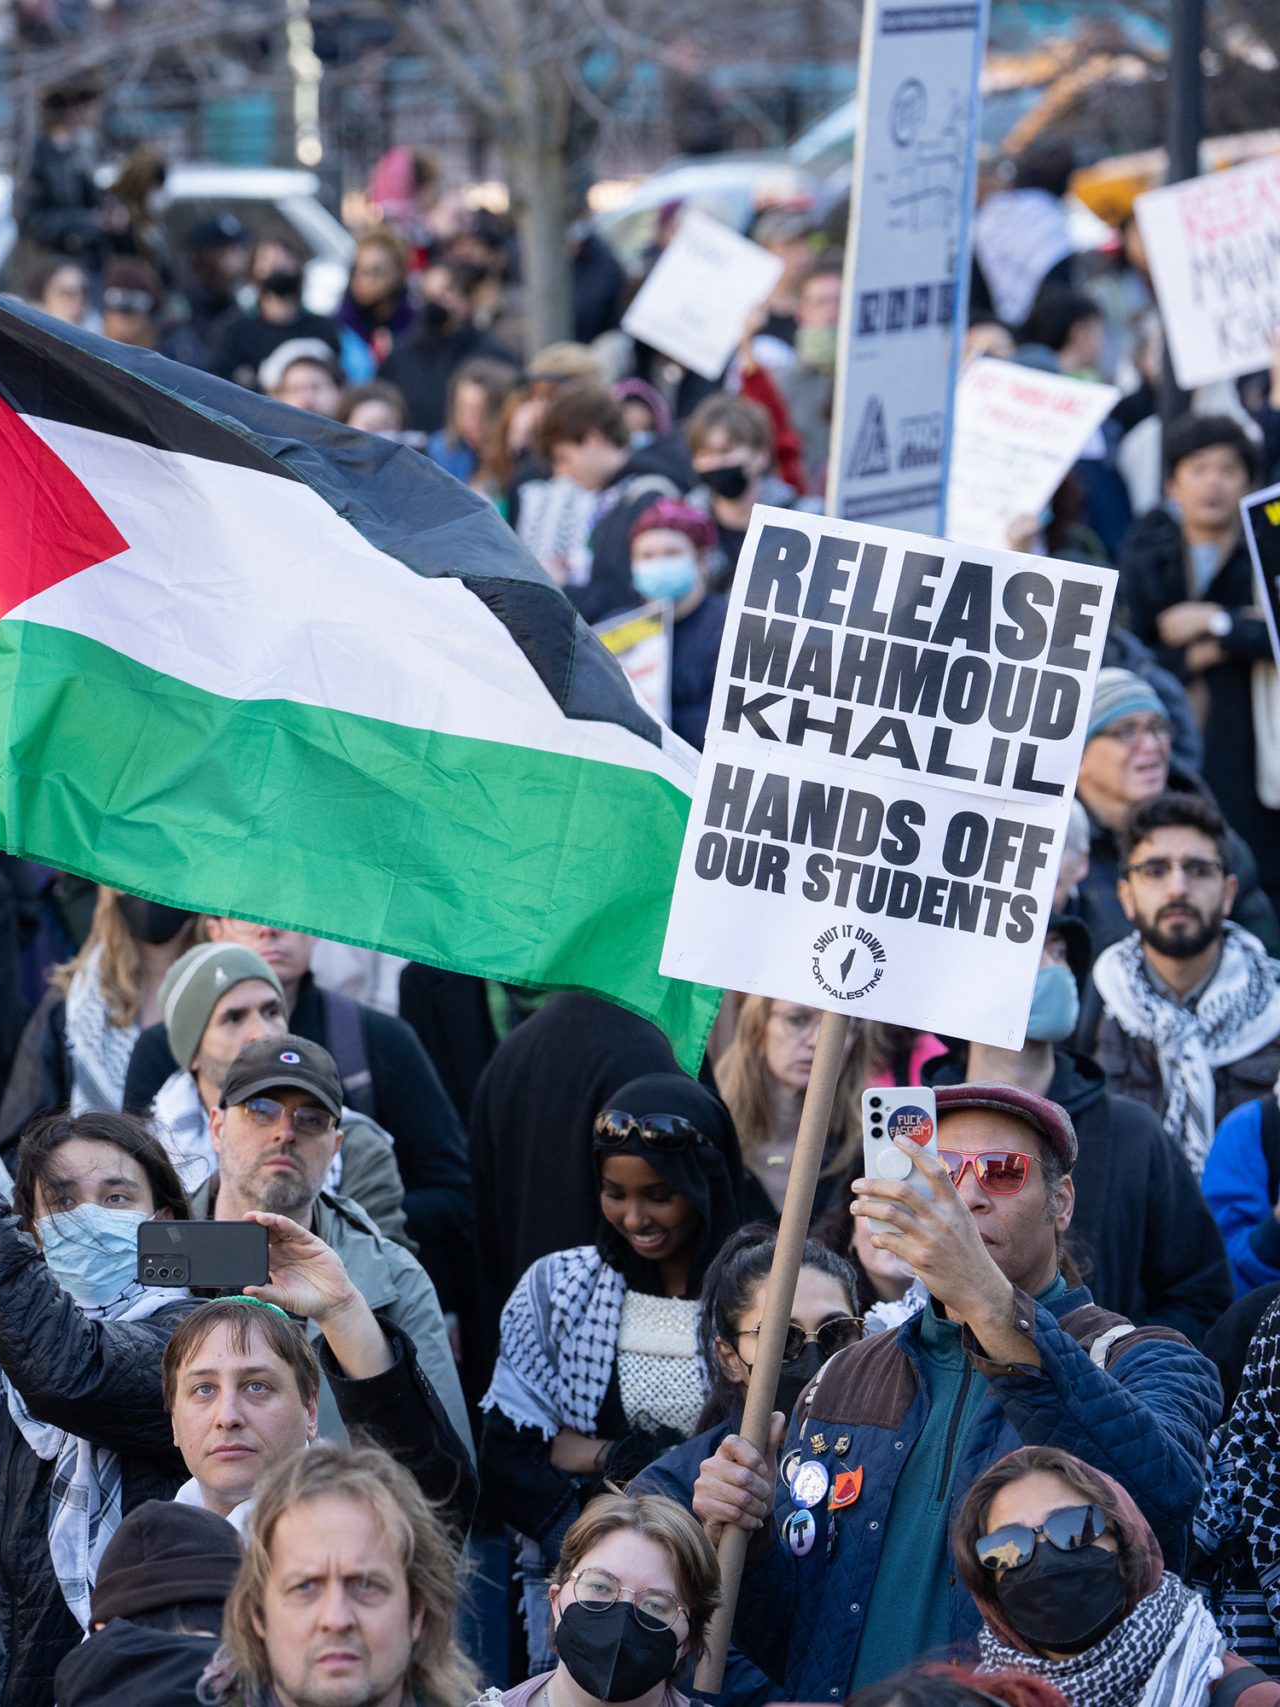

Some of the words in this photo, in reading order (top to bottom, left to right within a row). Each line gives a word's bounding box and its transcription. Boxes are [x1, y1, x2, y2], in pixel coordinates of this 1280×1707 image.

[744, 524, 1104, 671] RELEASE
[730, 611, 1081, 741] MAHMOUD
[722, 684, 1065, 797] KHALIL
[704, 763, 926, 867] HANDS
[942, 810, 1056, 891] OFF
[695, 832, 791, 895] OUR
[802, 853, 1039, 944] STUDENTS
[813, 926, 839, 954] SHUT
[842, 924, 853, 938] IT
[854, 927, 887, 963] DOWN!
[812, 957, 825, 985] FOR
[822, 967, 884, 1000] PALESTINE
[889, 1125, 931, 1137] FASCISM
[897, 1114, 923, 1126] FUCK
